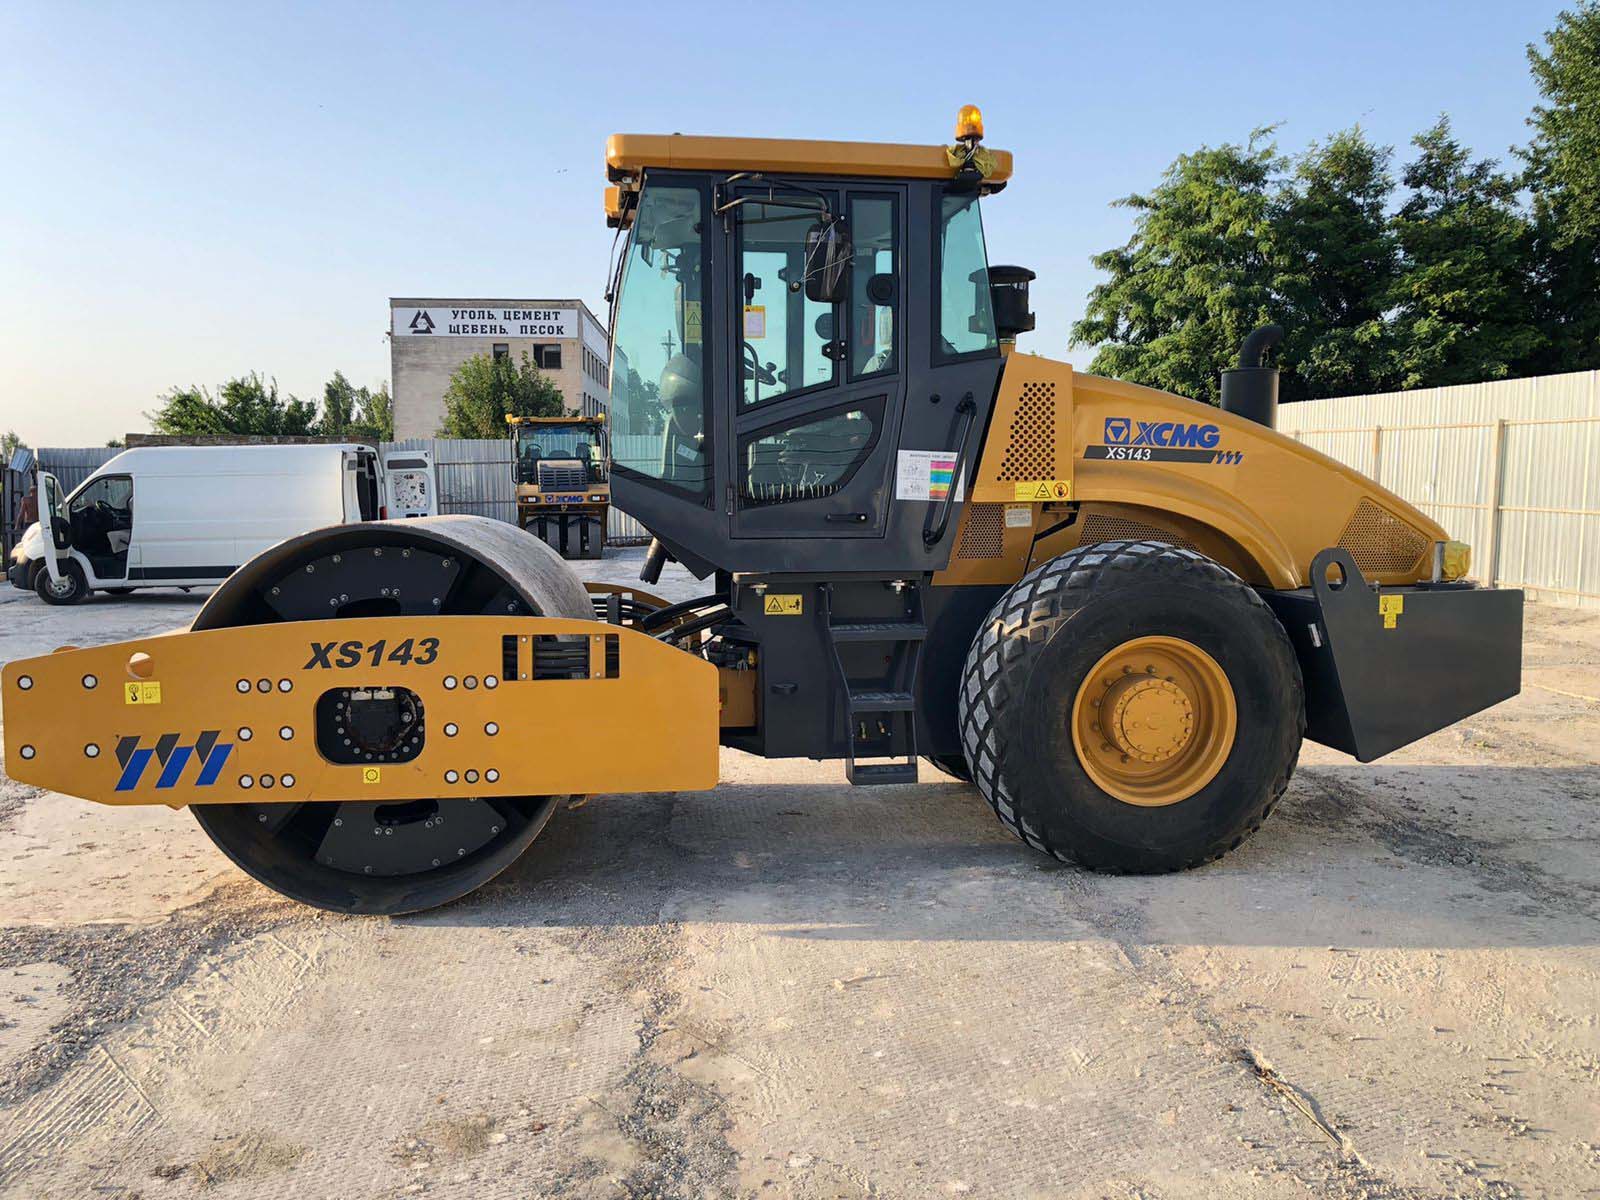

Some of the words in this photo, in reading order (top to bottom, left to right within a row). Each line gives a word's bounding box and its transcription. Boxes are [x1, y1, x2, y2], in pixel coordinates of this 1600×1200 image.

[503, 310, 561, 321] ЦЕМЕНТ
[519, 324, 565, 335] ПЕСОК
[1130, 421, 1221, 449] XCMG
[1105, 447, 1152, 461] XS143
[302, 637, 440, 670] XS143
